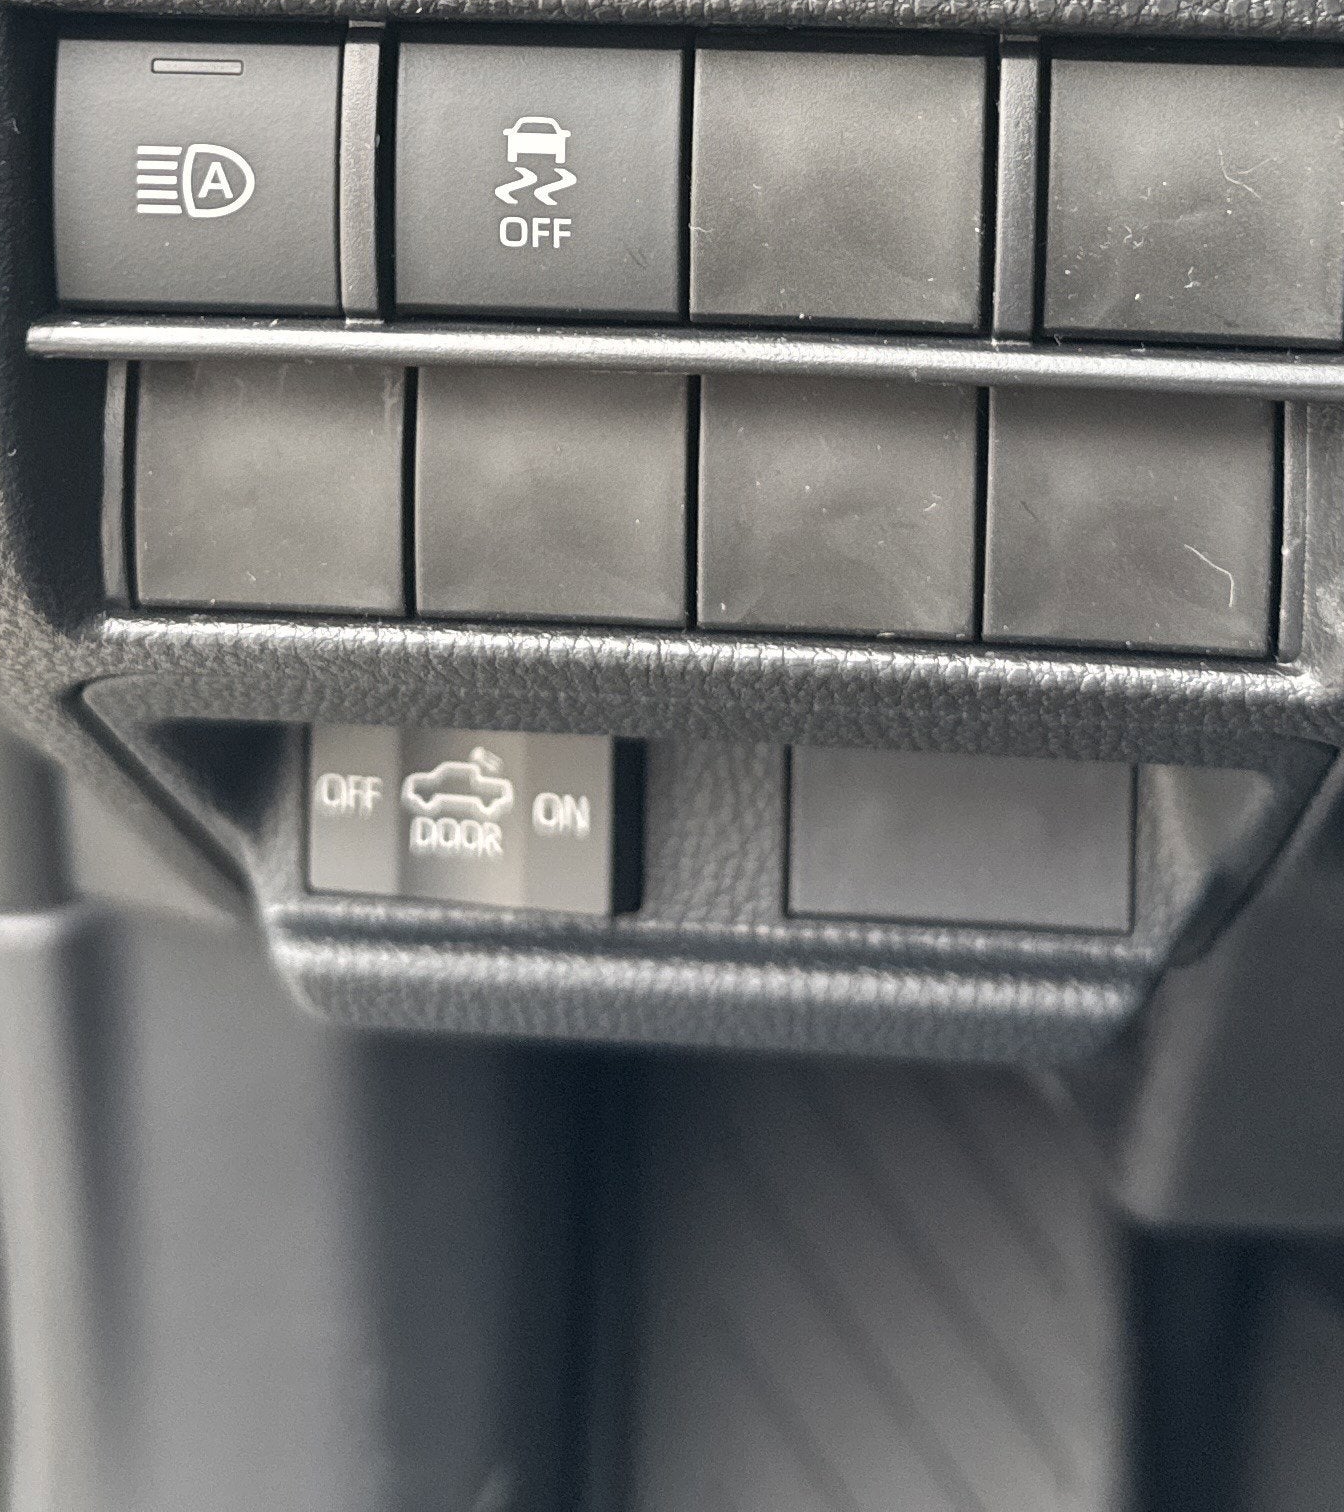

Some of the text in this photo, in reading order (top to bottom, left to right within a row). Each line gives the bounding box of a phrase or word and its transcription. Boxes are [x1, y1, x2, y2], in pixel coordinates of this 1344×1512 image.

[198, 162, 233, 199] A
[499, 217, 572, 248] OFF
[316, 772, 383, 816] OFF
[532, 791, 591, 838] ON
[409, 816, 504, 858] DOOR
